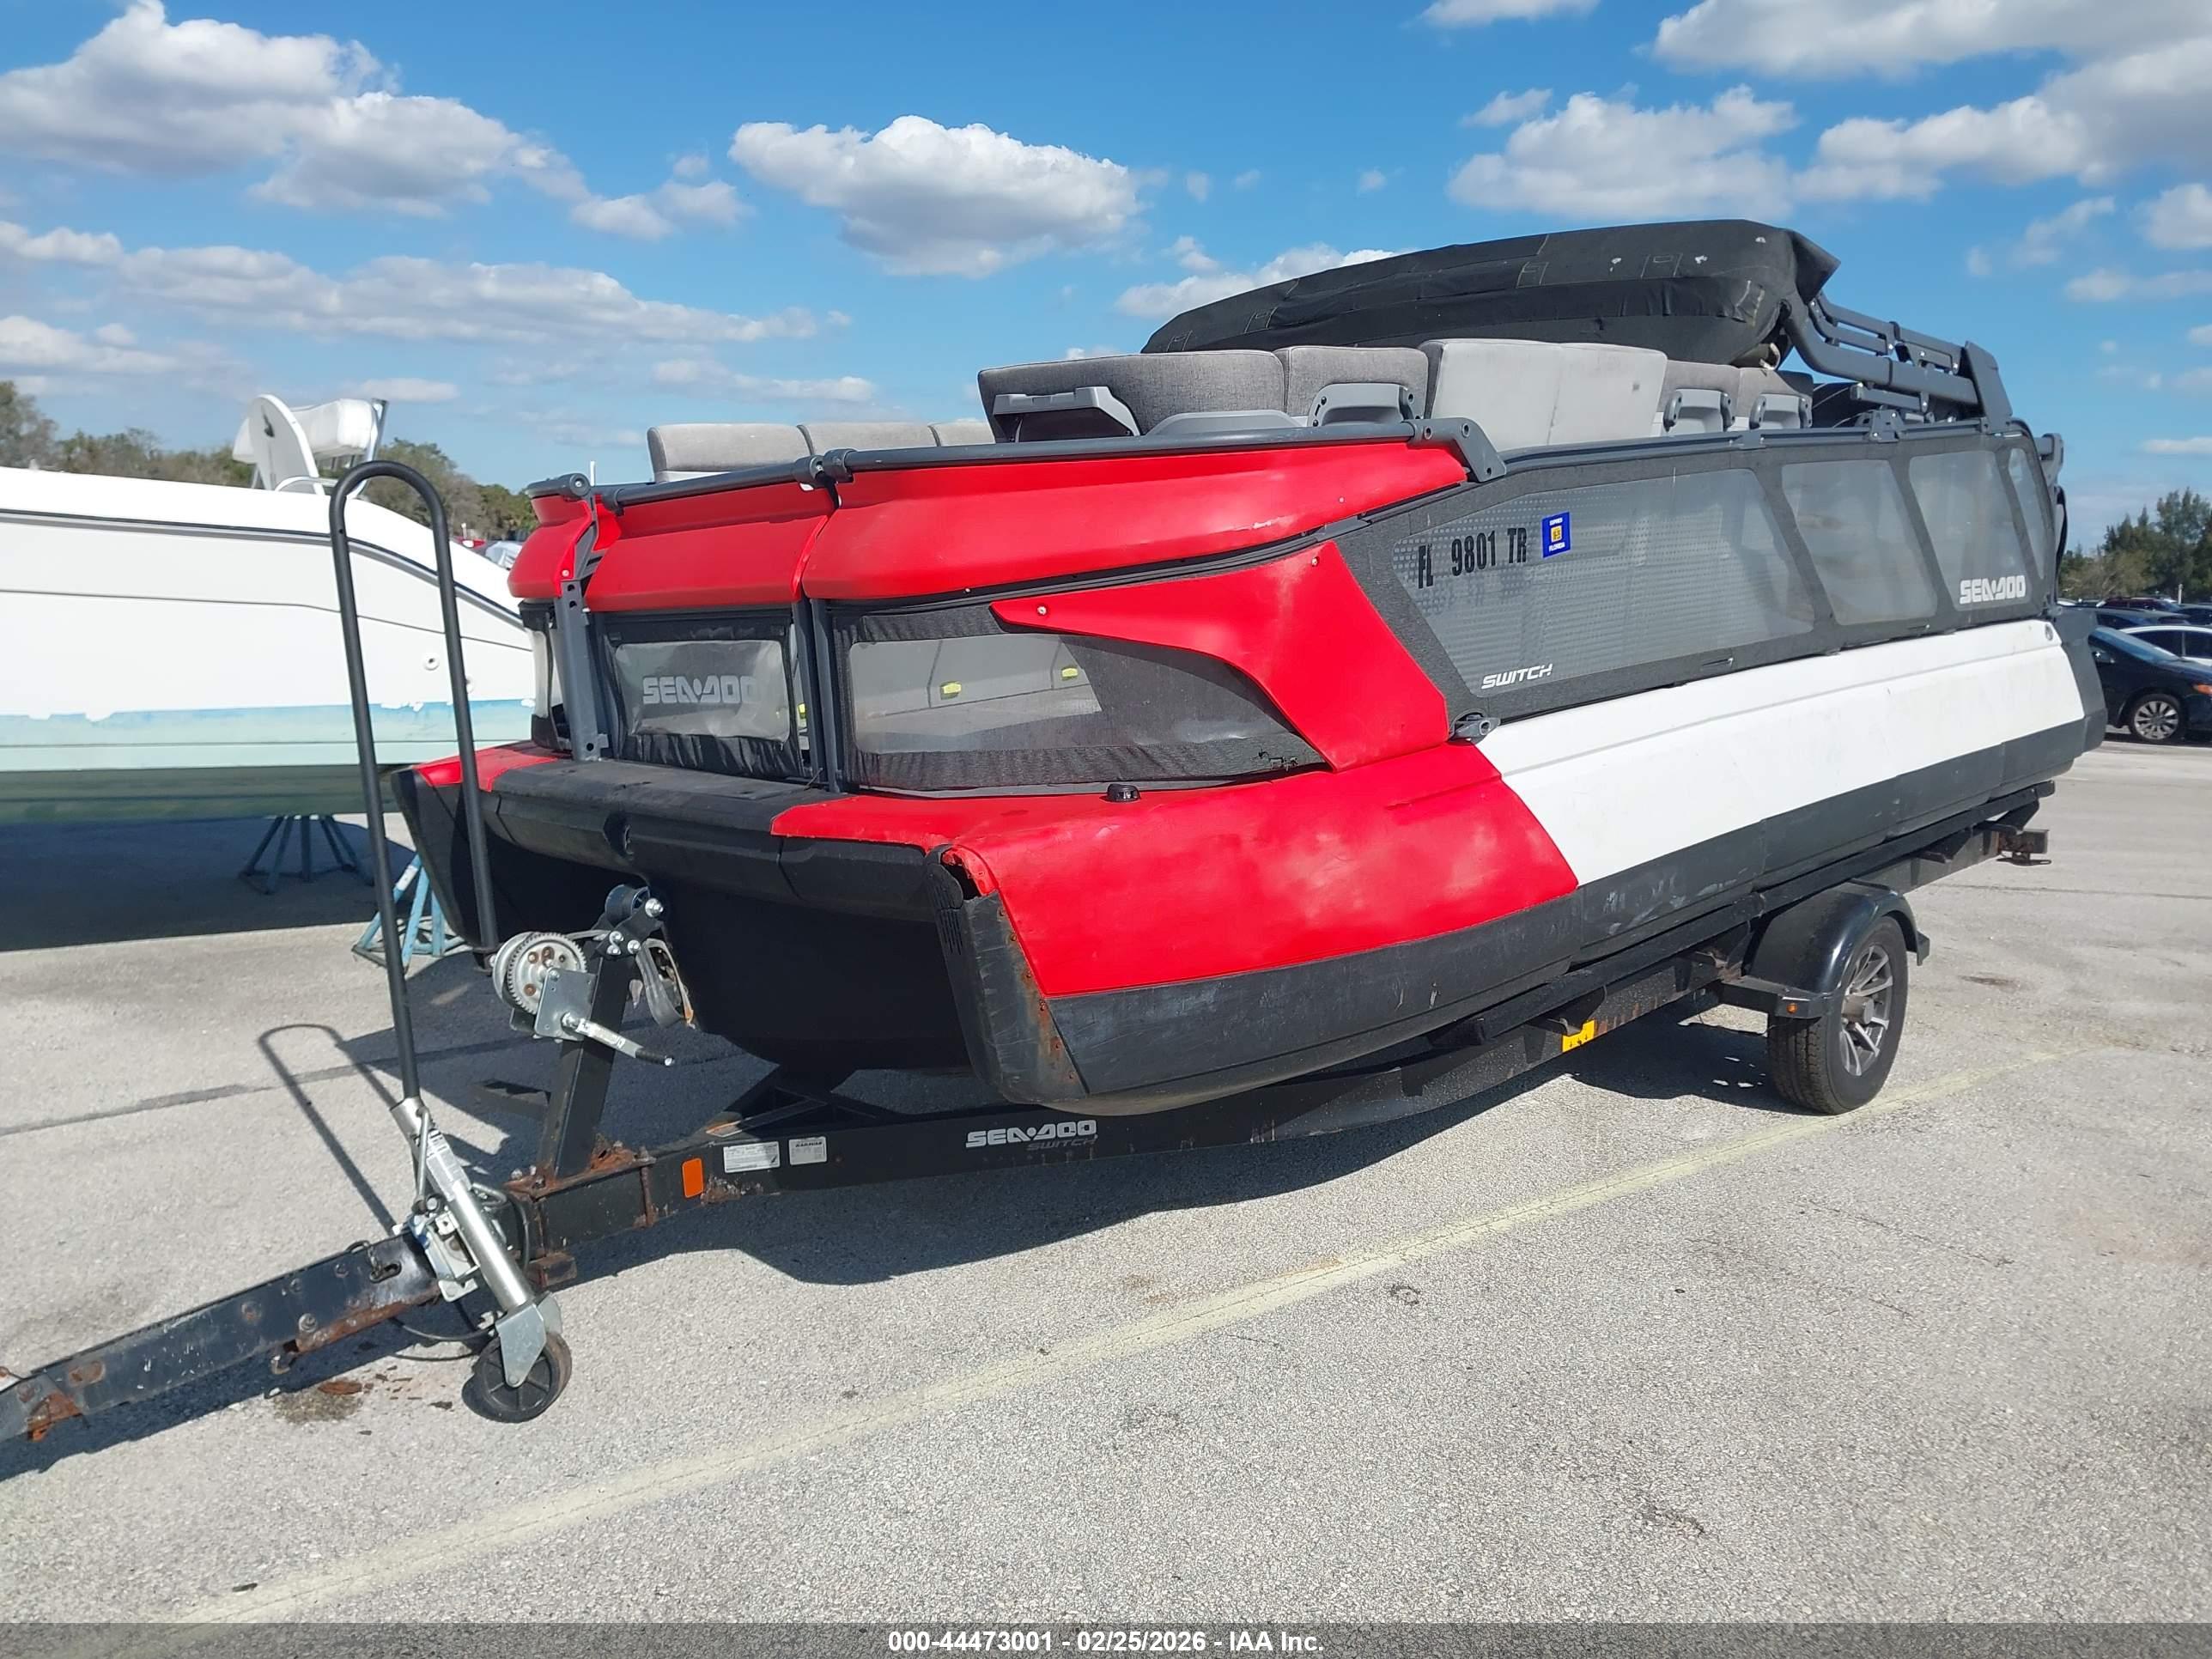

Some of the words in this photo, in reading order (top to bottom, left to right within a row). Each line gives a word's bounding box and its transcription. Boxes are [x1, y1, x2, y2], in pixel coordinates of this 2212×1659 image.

[1419, 544, 1434, 589] FL
[1451, 531, 1496, 576] 9801
[1507, 527, 1527, 563] TR
[1481, 664, 1553, 690] SWITCH
[1026, 1134, 1098, 1151] SWITCH
